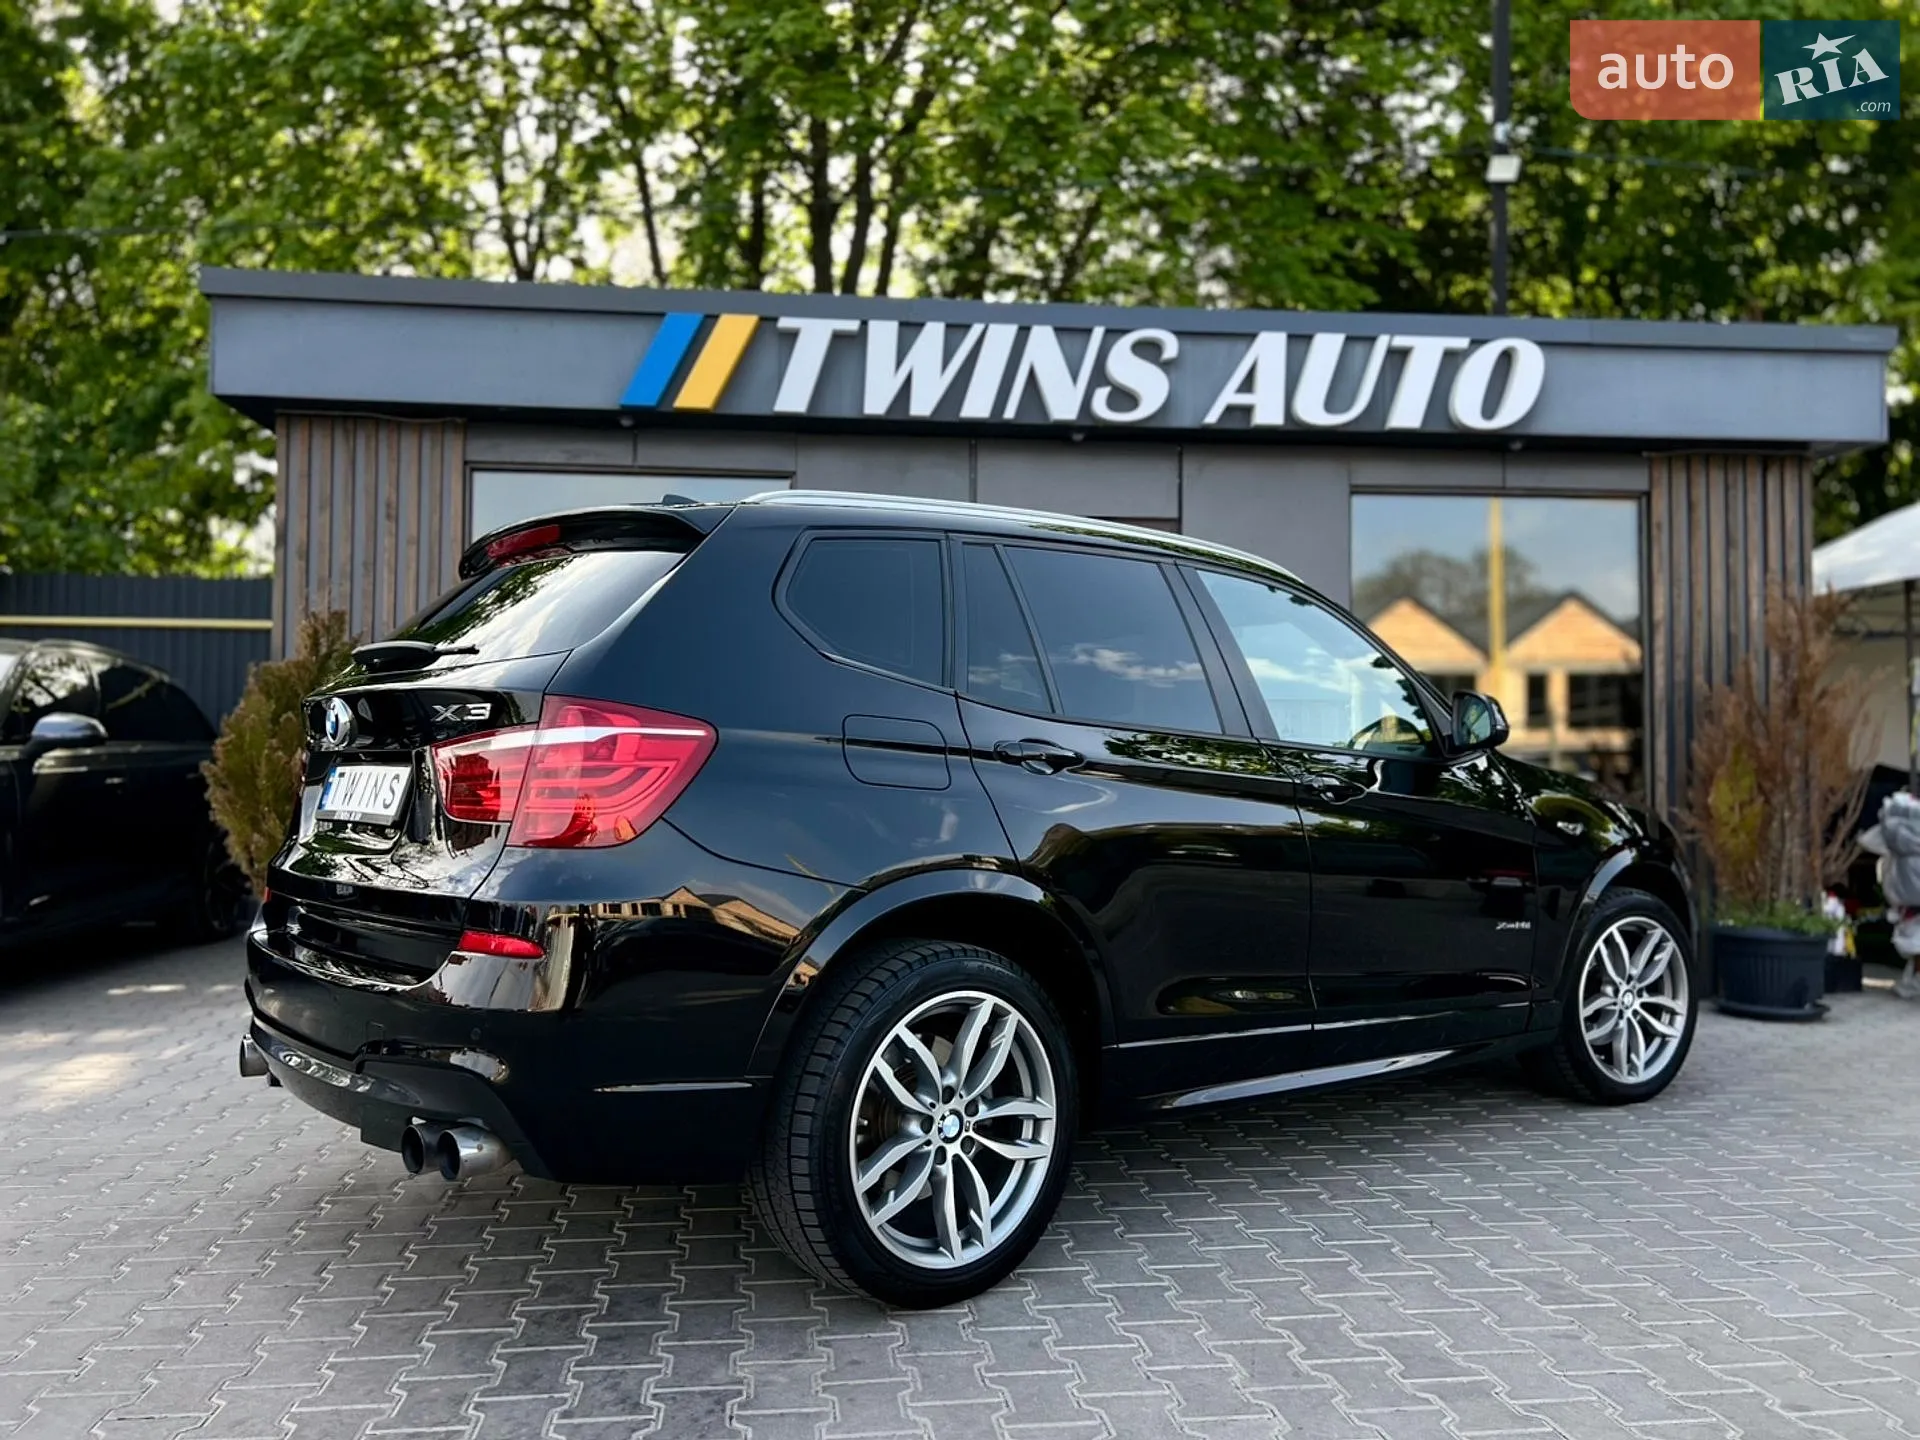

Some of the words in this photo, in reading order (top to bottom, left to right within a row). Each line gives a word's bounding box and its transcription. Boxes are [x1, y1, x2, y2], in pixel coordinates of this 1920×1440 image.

[773, 316, 1180, 423] TWINS
[1203, 330, 1546, 431] AUTO
[431, 703, 492, 722] X3
[330, 771, 401, 810] TWINS
